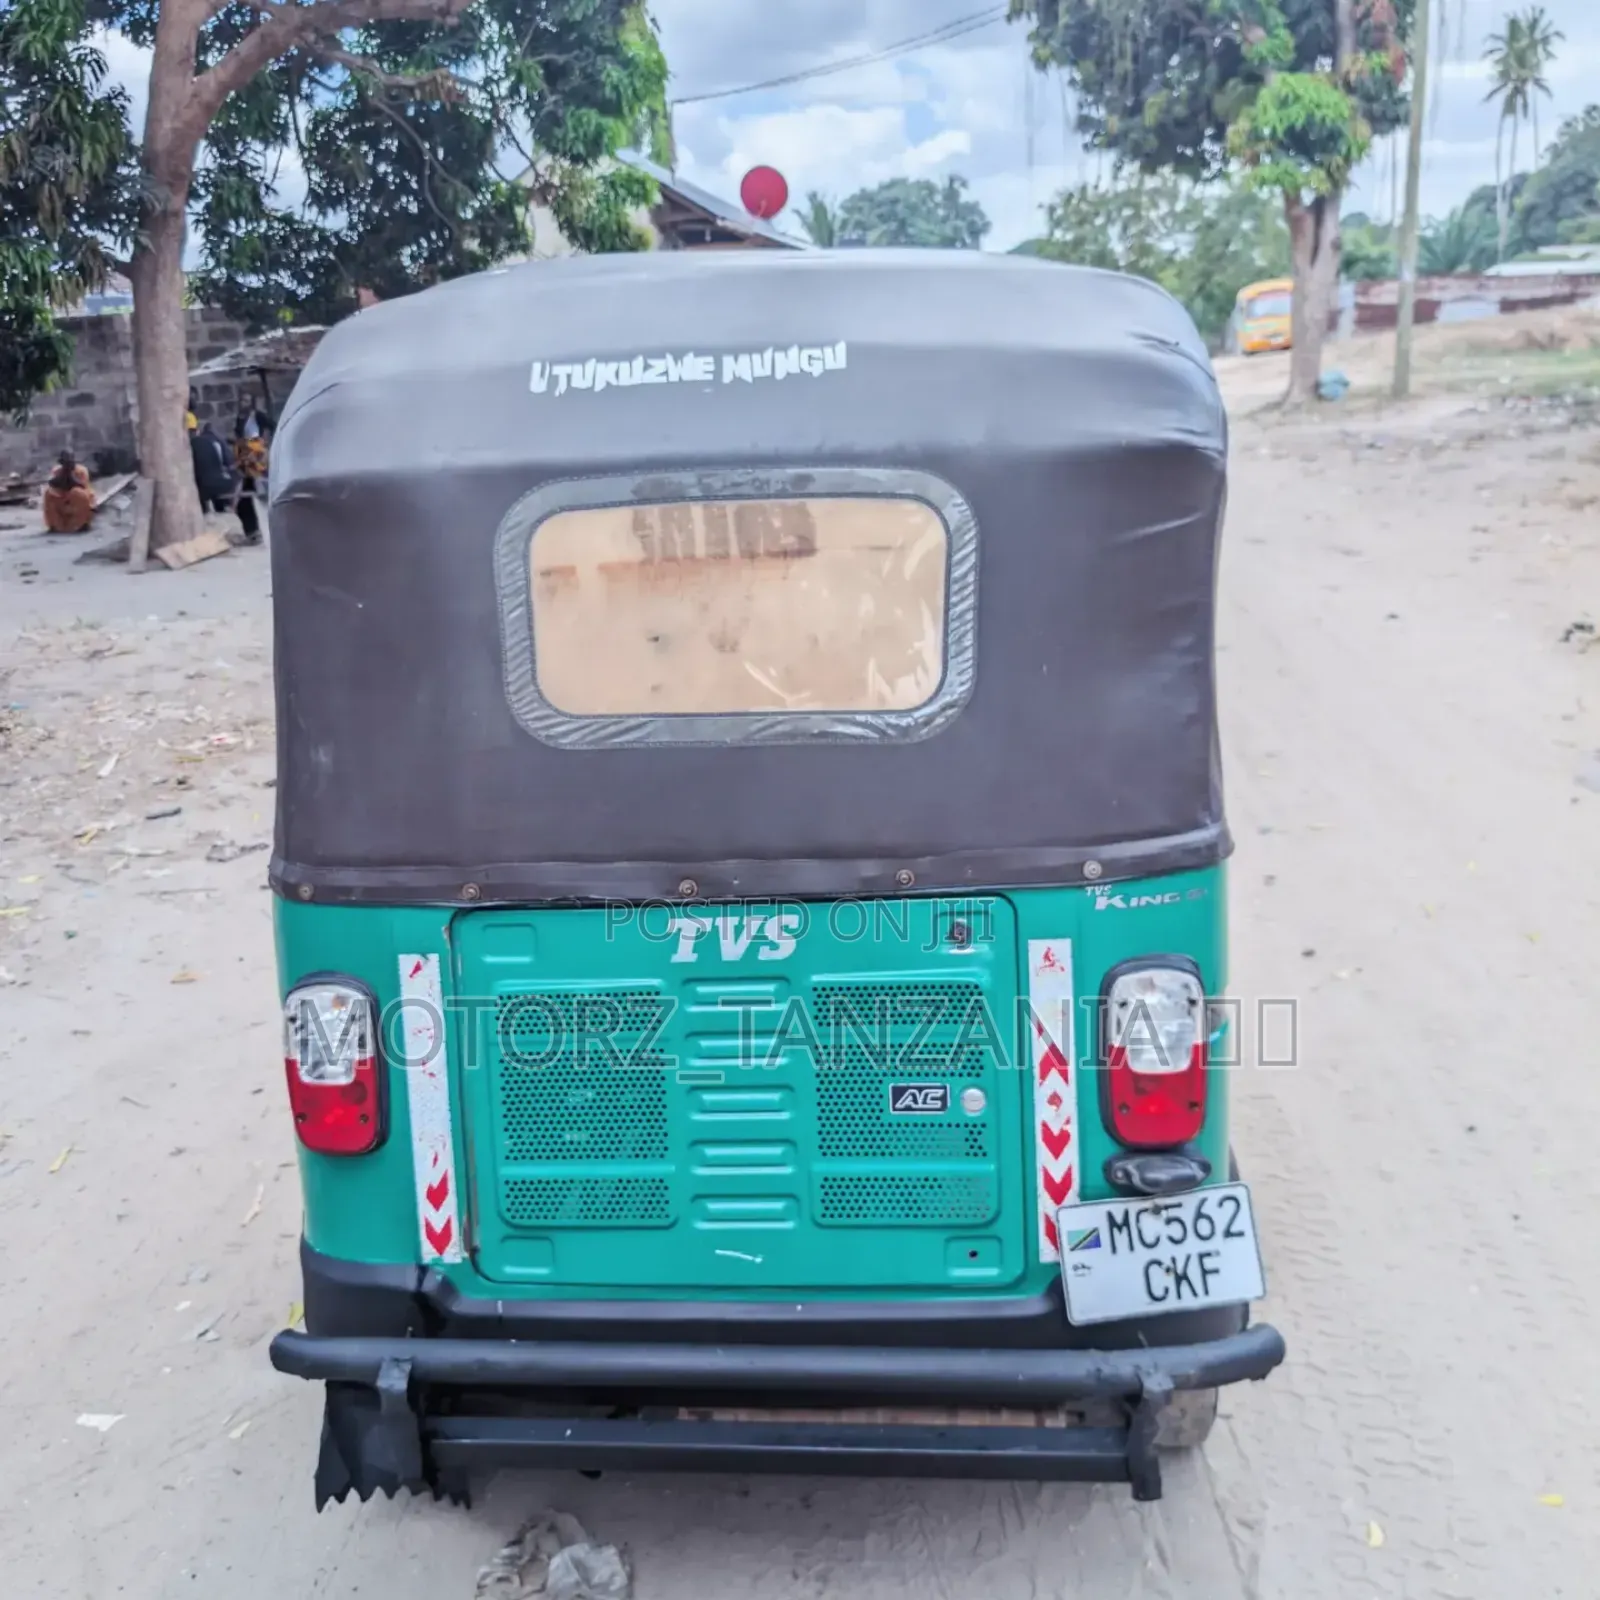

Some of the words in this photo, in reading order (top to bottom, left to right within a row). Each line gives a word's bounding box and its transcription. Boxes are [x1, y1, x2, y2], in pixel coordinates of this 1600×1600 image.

[529, 350, 715, 397] UTUKUZWE
[722, 340, 848, 384] MUNGU
[1085, 884, 1113, 897] TVS
[669, 915, 799, 964] TVS
[1106, 1195, 1246, 1255] MC562
[1143, 1248, 1221, 1302] CKF
